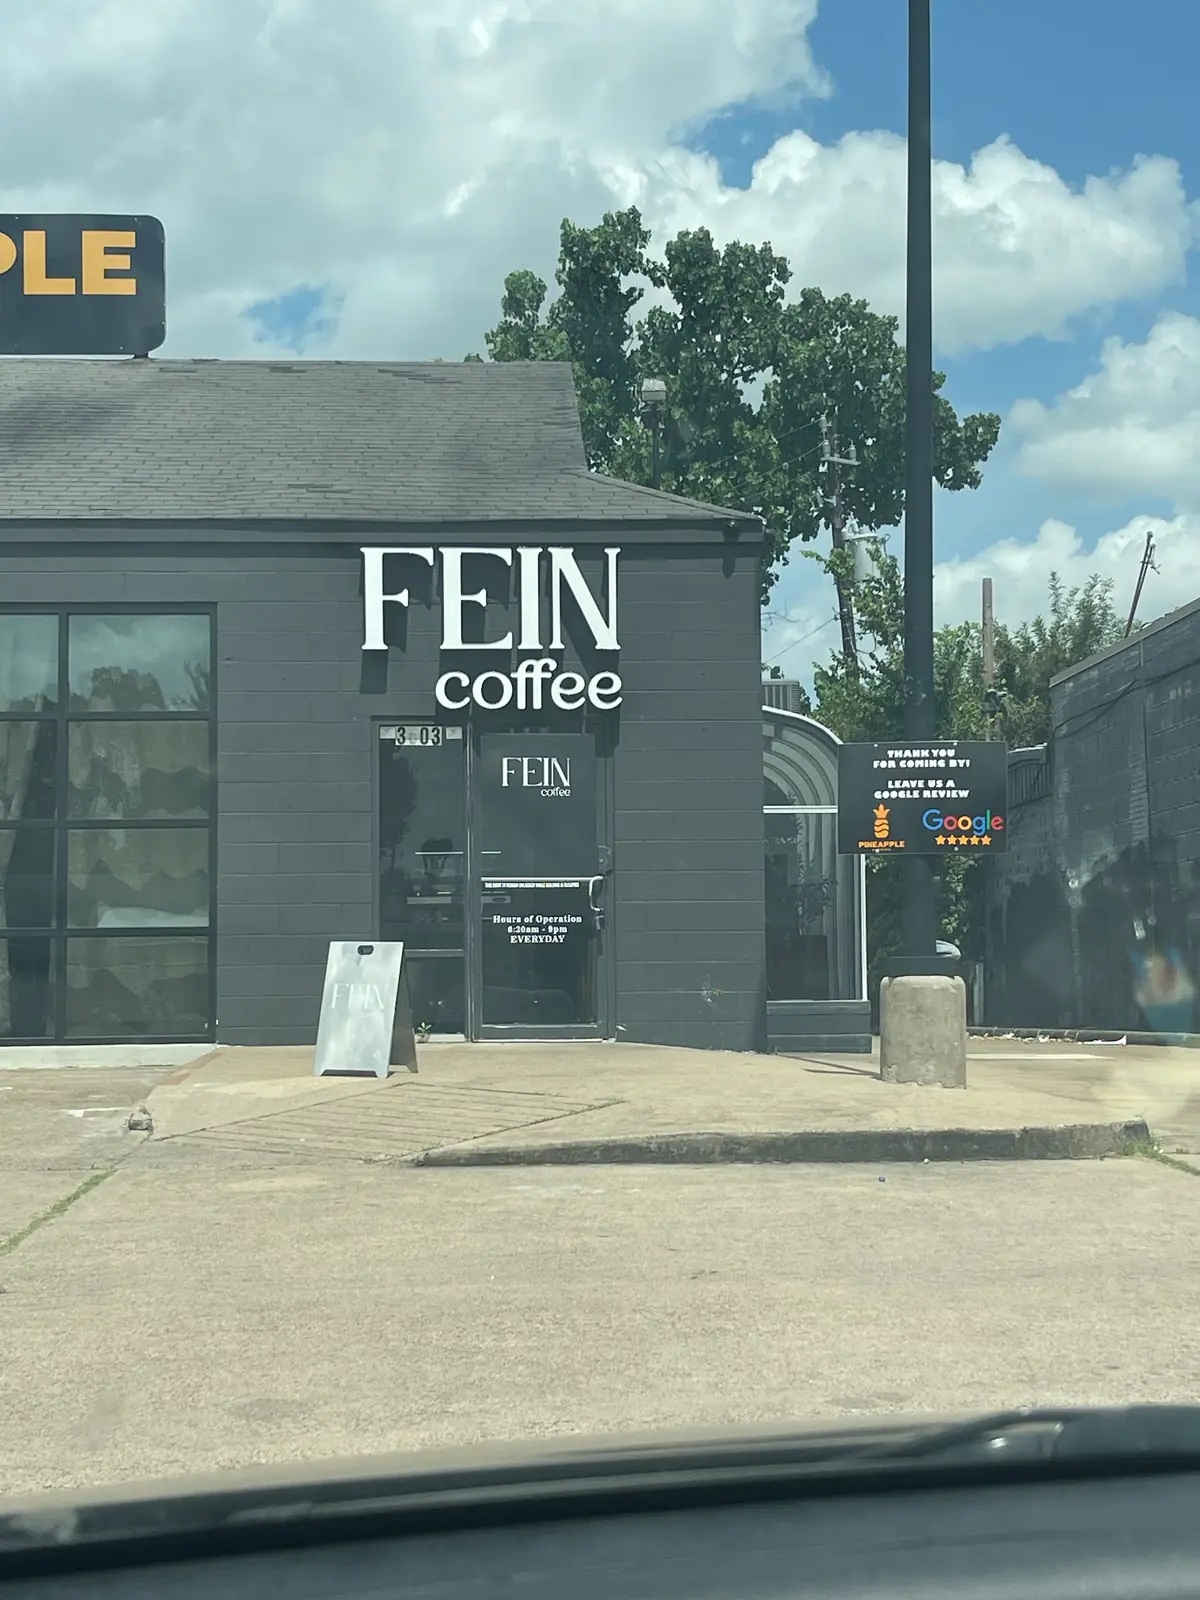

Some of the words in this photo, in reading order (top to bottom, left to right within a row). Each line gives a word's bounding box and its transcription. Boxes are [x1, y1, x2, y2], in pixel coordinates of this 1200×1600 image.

[360, 546, 621, 650] FEIN
[435, 658, 623, 710] coffee
[887, 749, 930, 758] THANK
[931, 748, 956, 758] YOU
[873, 760, 896, 769] FOR
[899, 759, 946, 768] COMING
[949, 759, 971, 768] BY!
[501, 757, 571, 787] FEIN
[888, 780, 925, 789] LEAVE
[927, 779, 944, 788] US
[945, 779, 956, 788] A
[540, 786, 571, 797] coffee
[873, 790, 920, 799] GOOGLE
[922, 789, 970, 799] REVIEW
[921, 808, 1004, 836] Google
[858, 840, 905, 849] PINEAPPLE
[492, 915, 522, 924] Hours
[523, 915, 534, 923] of
[535, 914, 582, 925] Operation
[547, 925, 568, 935] 9pm
[510, 935, 565, 943] EVERYDAY
